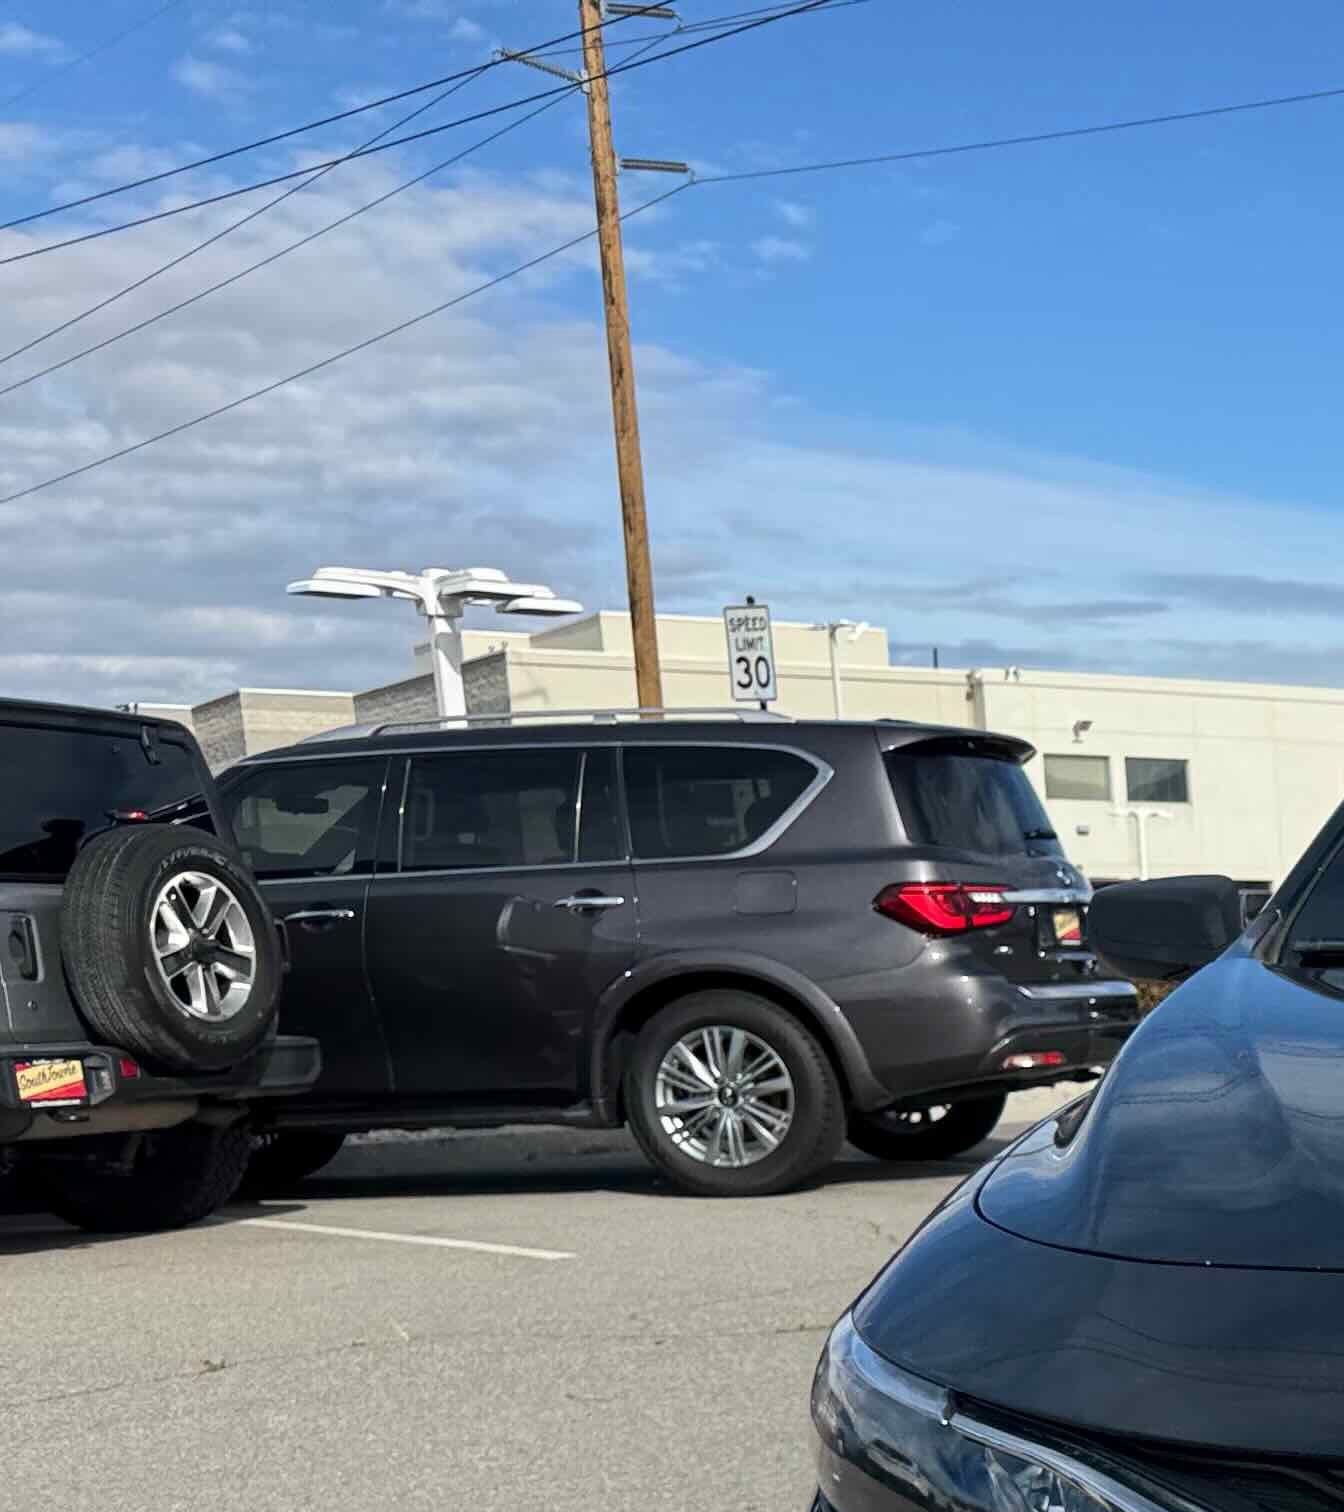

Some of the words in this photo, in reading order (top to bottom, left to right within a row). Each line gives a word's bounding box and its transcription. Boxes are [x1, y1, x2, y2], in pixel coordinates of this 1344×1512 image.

[729, 615, 767, 632] SPEED
[735, 636, 764, 652] LIMIT
[736, 655, 770, 688] 30
